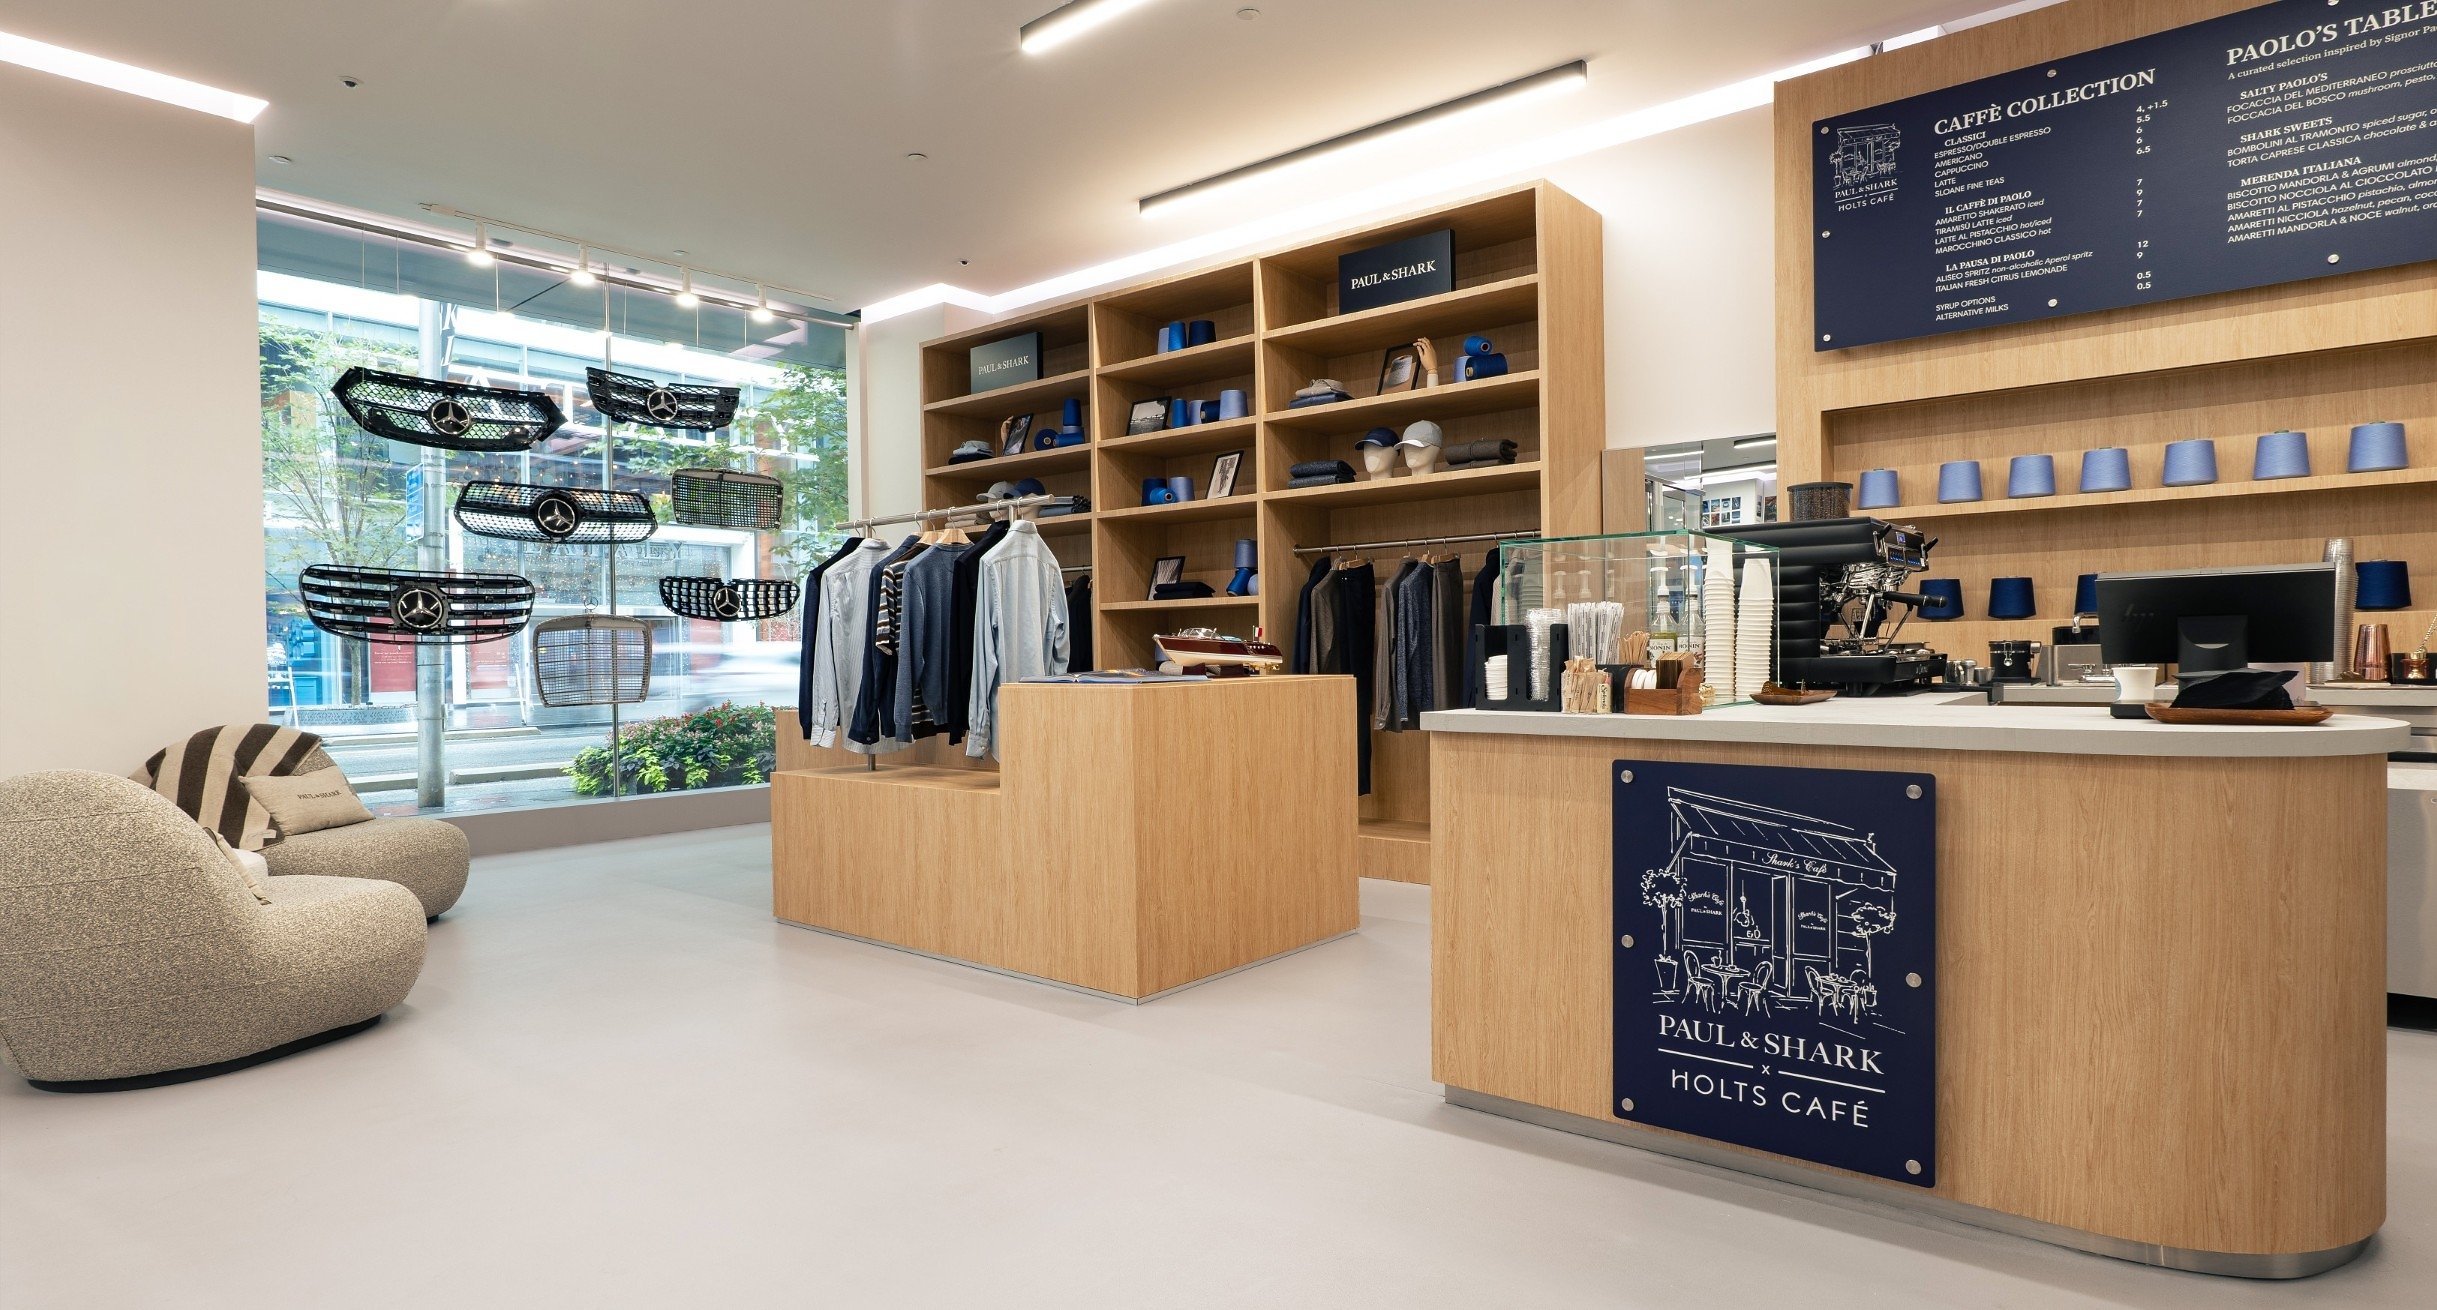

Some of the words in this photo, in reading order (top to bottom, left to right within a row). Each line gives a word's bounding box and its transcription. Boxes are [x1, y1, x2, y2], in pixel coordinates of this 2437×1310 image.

[2227, 24, 2337, 66] PAOLO'S
[2344, 0, 2437, 36] TABLE
[2228, 72, 2235, 80] A
[2237, 62, 2274, 77] curated
[2277, 53, 2321, 68] selection
[2324, 40, 2367, 57] inspired
[2369, 38, 2382, 47] by
[2384, 29, 2420, 43] Signor
[2227, 96, 2282, 113] FOCACCIA
[2284, 91, 2304, 101] DEL
[2306, 71, 2387, 96] MEDITERRANEO
[2240, 84, 2276, 100] SALTY
[2279, 73, 2328, 91] PAOLO'S
[1934, 103, 2002, 134] CAFFÈ
[2007, 68, 2155, 117] COLLECTION
[2148, 100, 2168, 110] +1.5
[2227, 106, 2282, 124] FOCCACIA
[2285, 102, 2304, 111] DEL
[2306, 92, 2346, 107] BOSCO
[2348, 81, 2402, 97] mushroom,
[2137, 114, 2150, 123] 5.5
[2240, 127, 2281, 143] SHARK
[2283, 117, 2332, 134] SWEETS
[1934, 136, 2007, 159] ESPRESSO/DOUBLE
[2009, 126, 2051, 142] ESPRESSO
[1944, 131, 1986, 147] CLASSICI
[2227, 139, 2282, 157] BOMBOLINI
[2285, 136, 2298, 145] AL
[2300, 123, 2360, 141] TRAMONTO
[2362, 115, 2396, 130] spiced
[2397, 110, 2427, 122] sugar,
[2227, 155, 2258, 167] TORTA
[2260, 145, 2305, 161] CAPRESE
[2308, 134, 2361, 151] CLASSICA
[2363, 124, 2417, 140] chocolate
[2419, 120, 2427, 129] &
[1934, 152, 1983, 169] AMERICANO
[2136, 146, 2150, 154] 6.5
[1934, 160, 1989, 178] CAPPUCCINO
[2227, 184, 2277, 200] BISCOTTO
[2279, 173, 2339, 190] MANDORLA
[2351, 162, 2394, 176] AGRUMI
[2241, 169, 2300, 187] MERENDA
[2303, 156, 2362, 175] ITALIANA
[1835, 189, 1857, 198] PAUL
[1865, 178, 1897, 191] SHARK
[1934, 177, 1956, 188] LATTE
[1935, 185, 1965, 197] SLOANE
[1967, 181, 1983, 190] FINE
[1985, 177, 2005, 186] TEAS
[2136, 189, 2143, 197] 9
[2227, 195, 2277, 211] BISCOTTO
[2279, 184, 2337, 201] NOCCIOLA
[2339, 181, 2353, 190] AL
[2355, 166, 2433, 187] CIOCCOLATO
[1839, 200, 1866, 211] HOLTS
[1870, 193, 1894, 204] CAFÉ
[1935, 212, 1977, 226] AMARETTO
[1979, 202, 2026, 217] SHAKERATO
[2027, 198, 2045, 208] iced
[1945, 206, 1955, 214] IL
[1956, 199, 1986, 212] CAFFÈ
[1988, 197, 1998, 205] DI
[2000, 190, 2032, 203] PAOLO
[2137, 210, 2142, 218] 7
[2227, 207, 2275, 222] AMARETTI
[2277, 205, 2290, 213] AL
[2292, 192, 2356, 210] PISTACCHIO
[2358, 184, 2405, 200] pistachio,
[2227, 218, 2275, 233] AMARETTI
[2277, 209, 2329, 224] NICCIOLA
[2331, 201, 2375, 214] hazelnut,
[2377, 196, 2412, 208] pecan,
[1935, 235, 1956, 245] LATTE
[1970, 223, 2019, 238] PISTACCHIO
[2020, 217, 2052, 229] hot/iced
[1972, 218, 1994, 228] LATTE
[1996, 215, 2013, 223] iced
[2227, 229, 2275, 243] AMARETTI
[2277, 218, 2337, 235] MANDORLA
[2339, 216, 2347, 224] &
[2349, 210, 2382, 222] NOCE
[2385, 205, 2420, 216] walnut,
[1935, 238, 1993, 254] MAROCCHINO
[1994, 230, 2037, 244] CLASSICO
[1936, 272, 1963, 283] ALISEO
[1965, 267, 1990, 278] SPRITZ
[1991, 259, 2043, 273] non-alcoholic
[2044, 254, 2071, 265] Aperol
[2071, 251, 2093, 261] spritz
[1946, 264, 1958, 272] LA
[1960, 258, 1989, 269] PAUSA
[1991, 256, 2001, 264] DI
[2003, 250, 2035, 262] PAOLO
[1351, 274, 1381, 289] PAUL
[1391, 260, 1436, 280] SHARK
[1935, 282, 1963, 292] ITALIAN
[1965, 278, 1989, 287] FRESH
[1991, 272, 2019, 283] CITRUS
[2021, 264, 2067, 278] LEMONADE
[2137, 271, 2151, 280] 0.5
[2137, 282, 2151, 290] 0.5
[1936, 302, 1960, 311] SYRUP
[1961, 296, 1996, 307] OPTIONS
[1936, 307, 1983, 321] ALTERNATIVE
[1985, 304, 2009, 313] MILKS
[979, 364, 996, 375] PAUL
[1003, 356, 1029, 369] SHARK
[1762, 852, 1800, 868] Shark's
[1804, 859, 1827, 876] Café
[1659, 1014, 1736, 1048] PAUL
[1740, 1031, 1760, 1049] &
[1764, 1032, 1885, 1075] SHARK
[1672, 1069, 1767, 1106] HOLTS
[1782, 1092, 1869, 1128] CAFÉ
